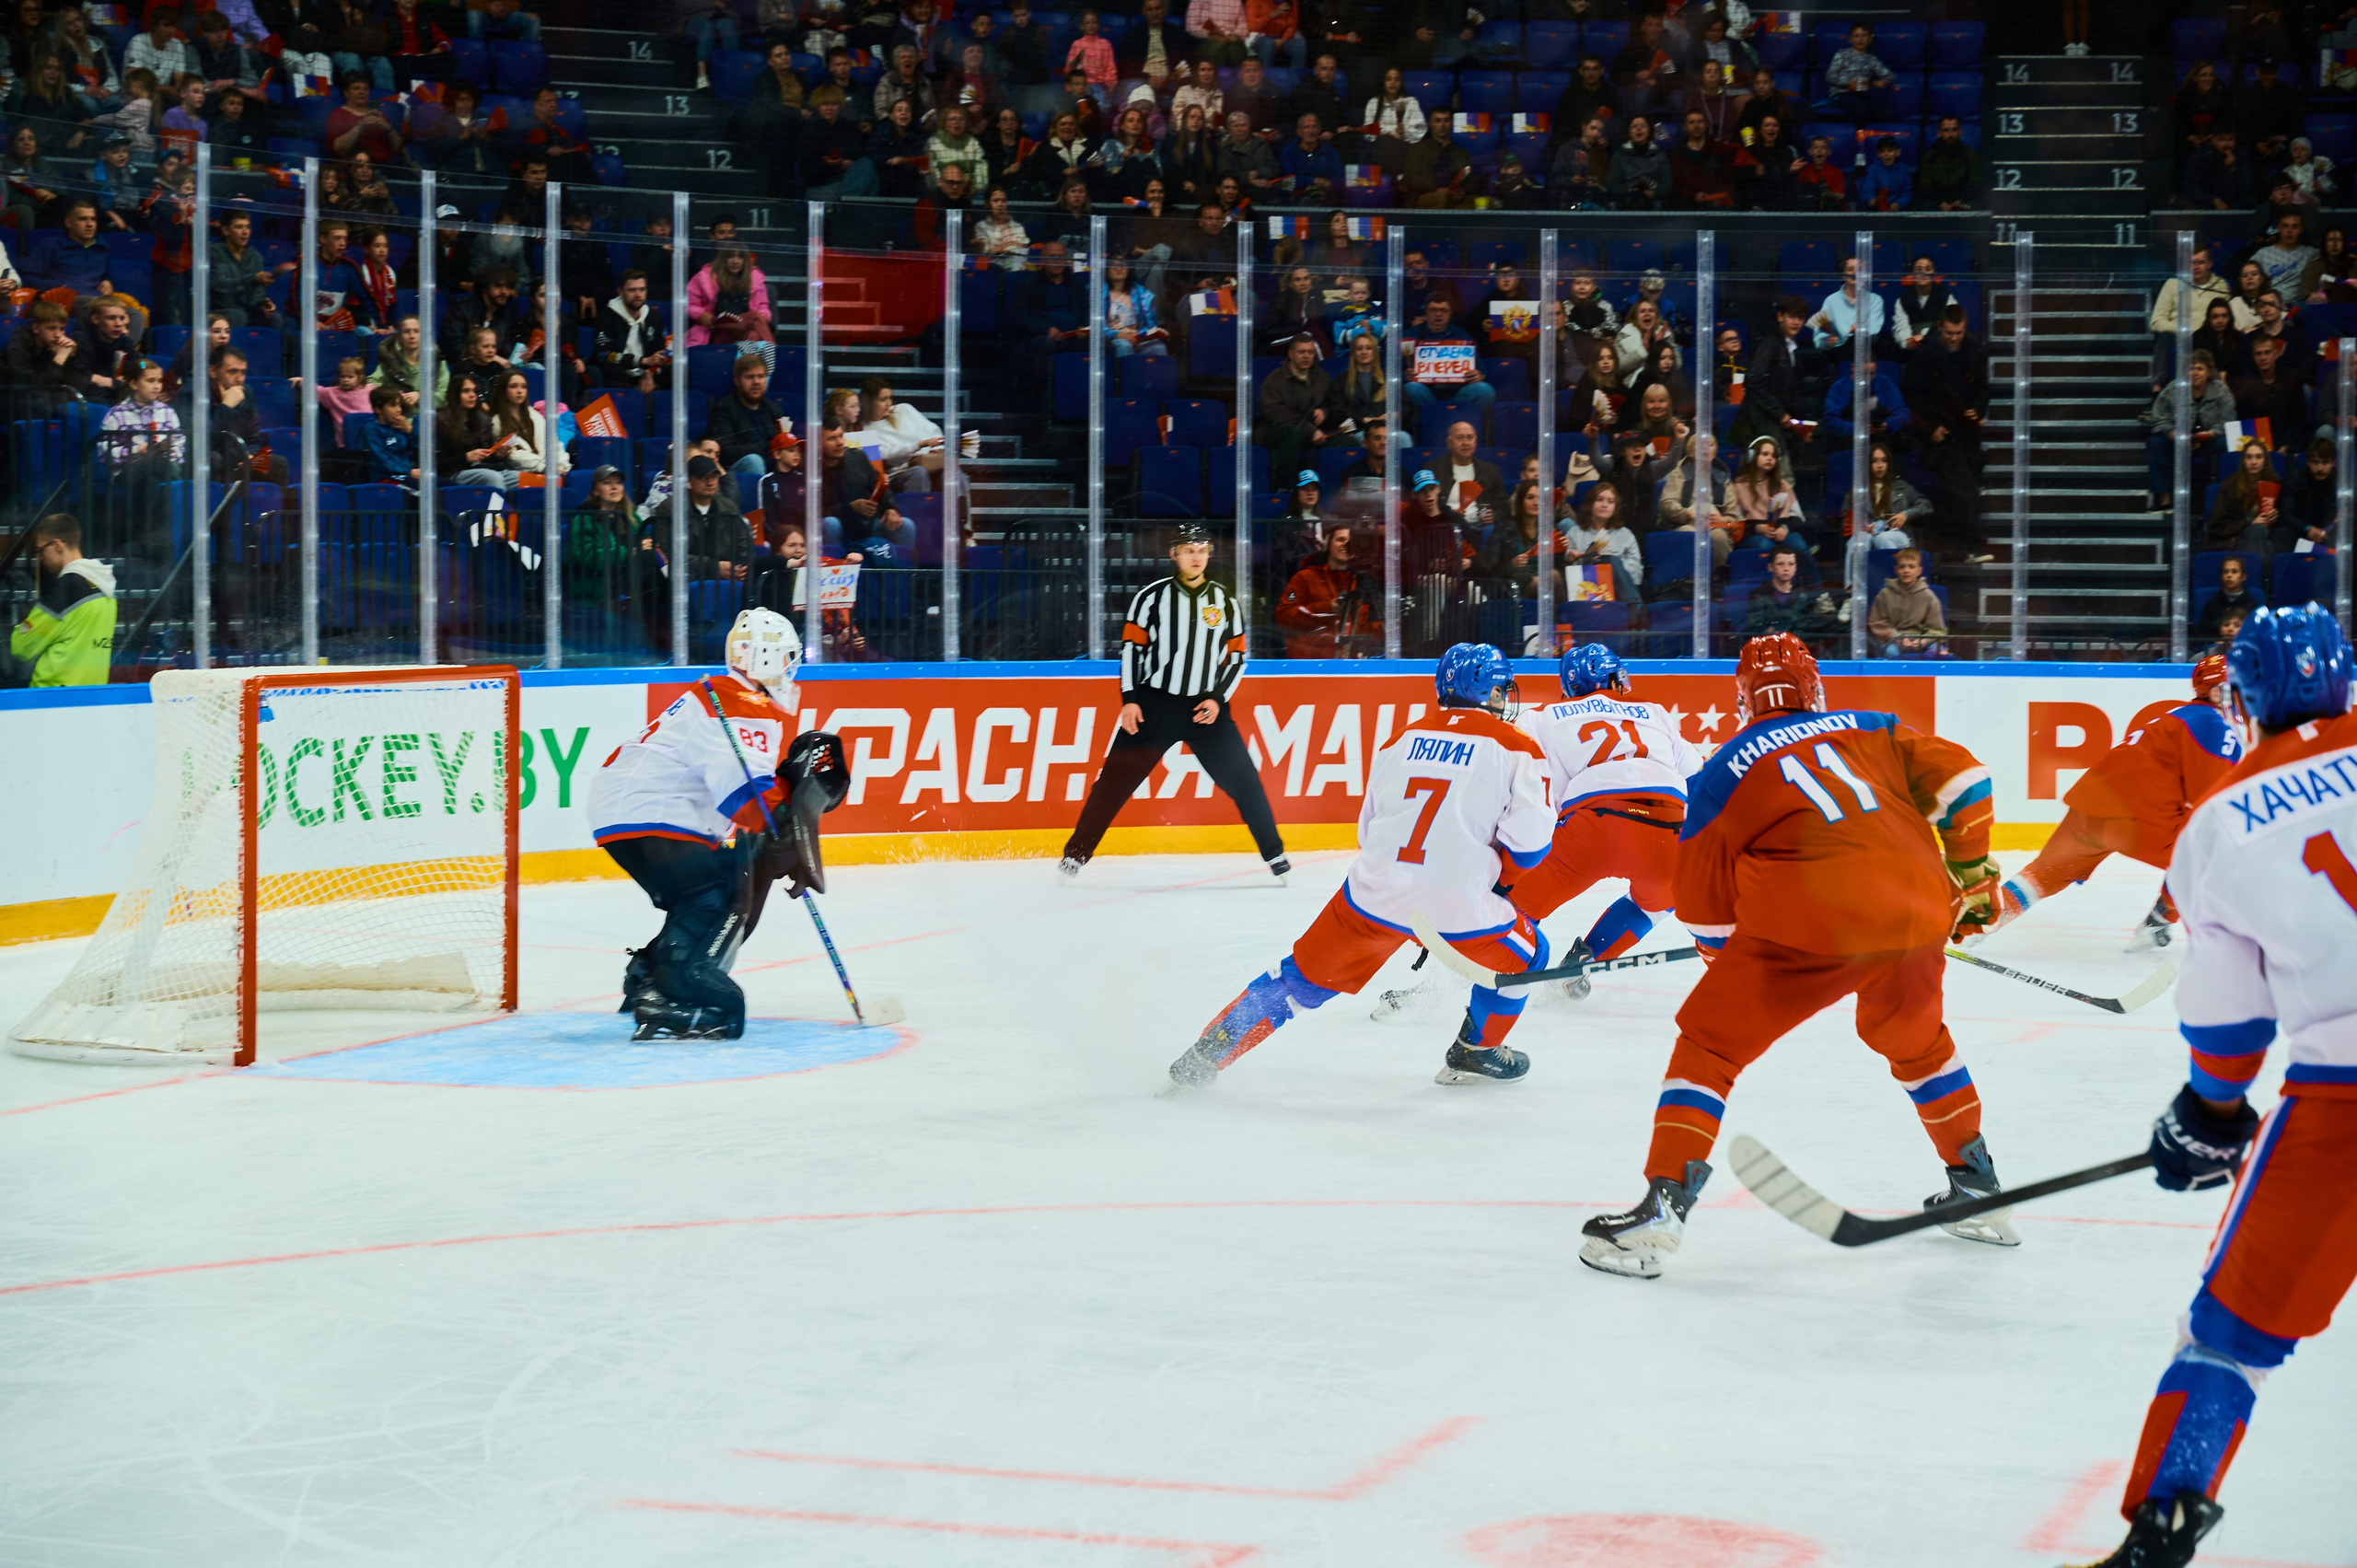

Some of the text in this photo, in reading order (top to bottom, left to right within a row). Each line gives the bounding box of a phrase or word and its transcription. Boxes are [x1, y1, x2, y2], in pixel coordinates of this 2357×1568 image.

[627, 41, 654, 61] 14
[2003, 63, 2029, 83] 14
[2109, 62, 2135, 83] 14
[664, 95, 690, 116] 13
[1997, 113, 2025, 134] 13
[2112, 112, 2139, 133] 13
[705, 149, 733, 169] 12
[1995, 168, 2022, 191] 12
[2111, 168, 2138, 190] 12
[749, 207, 771, 228] 11
[2114, 223, 2136, 246] 11
[1407, 738, 1475, 766] ЛЯЛИН
[1577, 719, 1649, 767] 21
[1726, 714, 1859, 780] KHARIONOV
[1777, 740, 1880, 826] 11
[1396, 776, 1452, 865] 7
[1582, 952, 1667, 977] CCM
